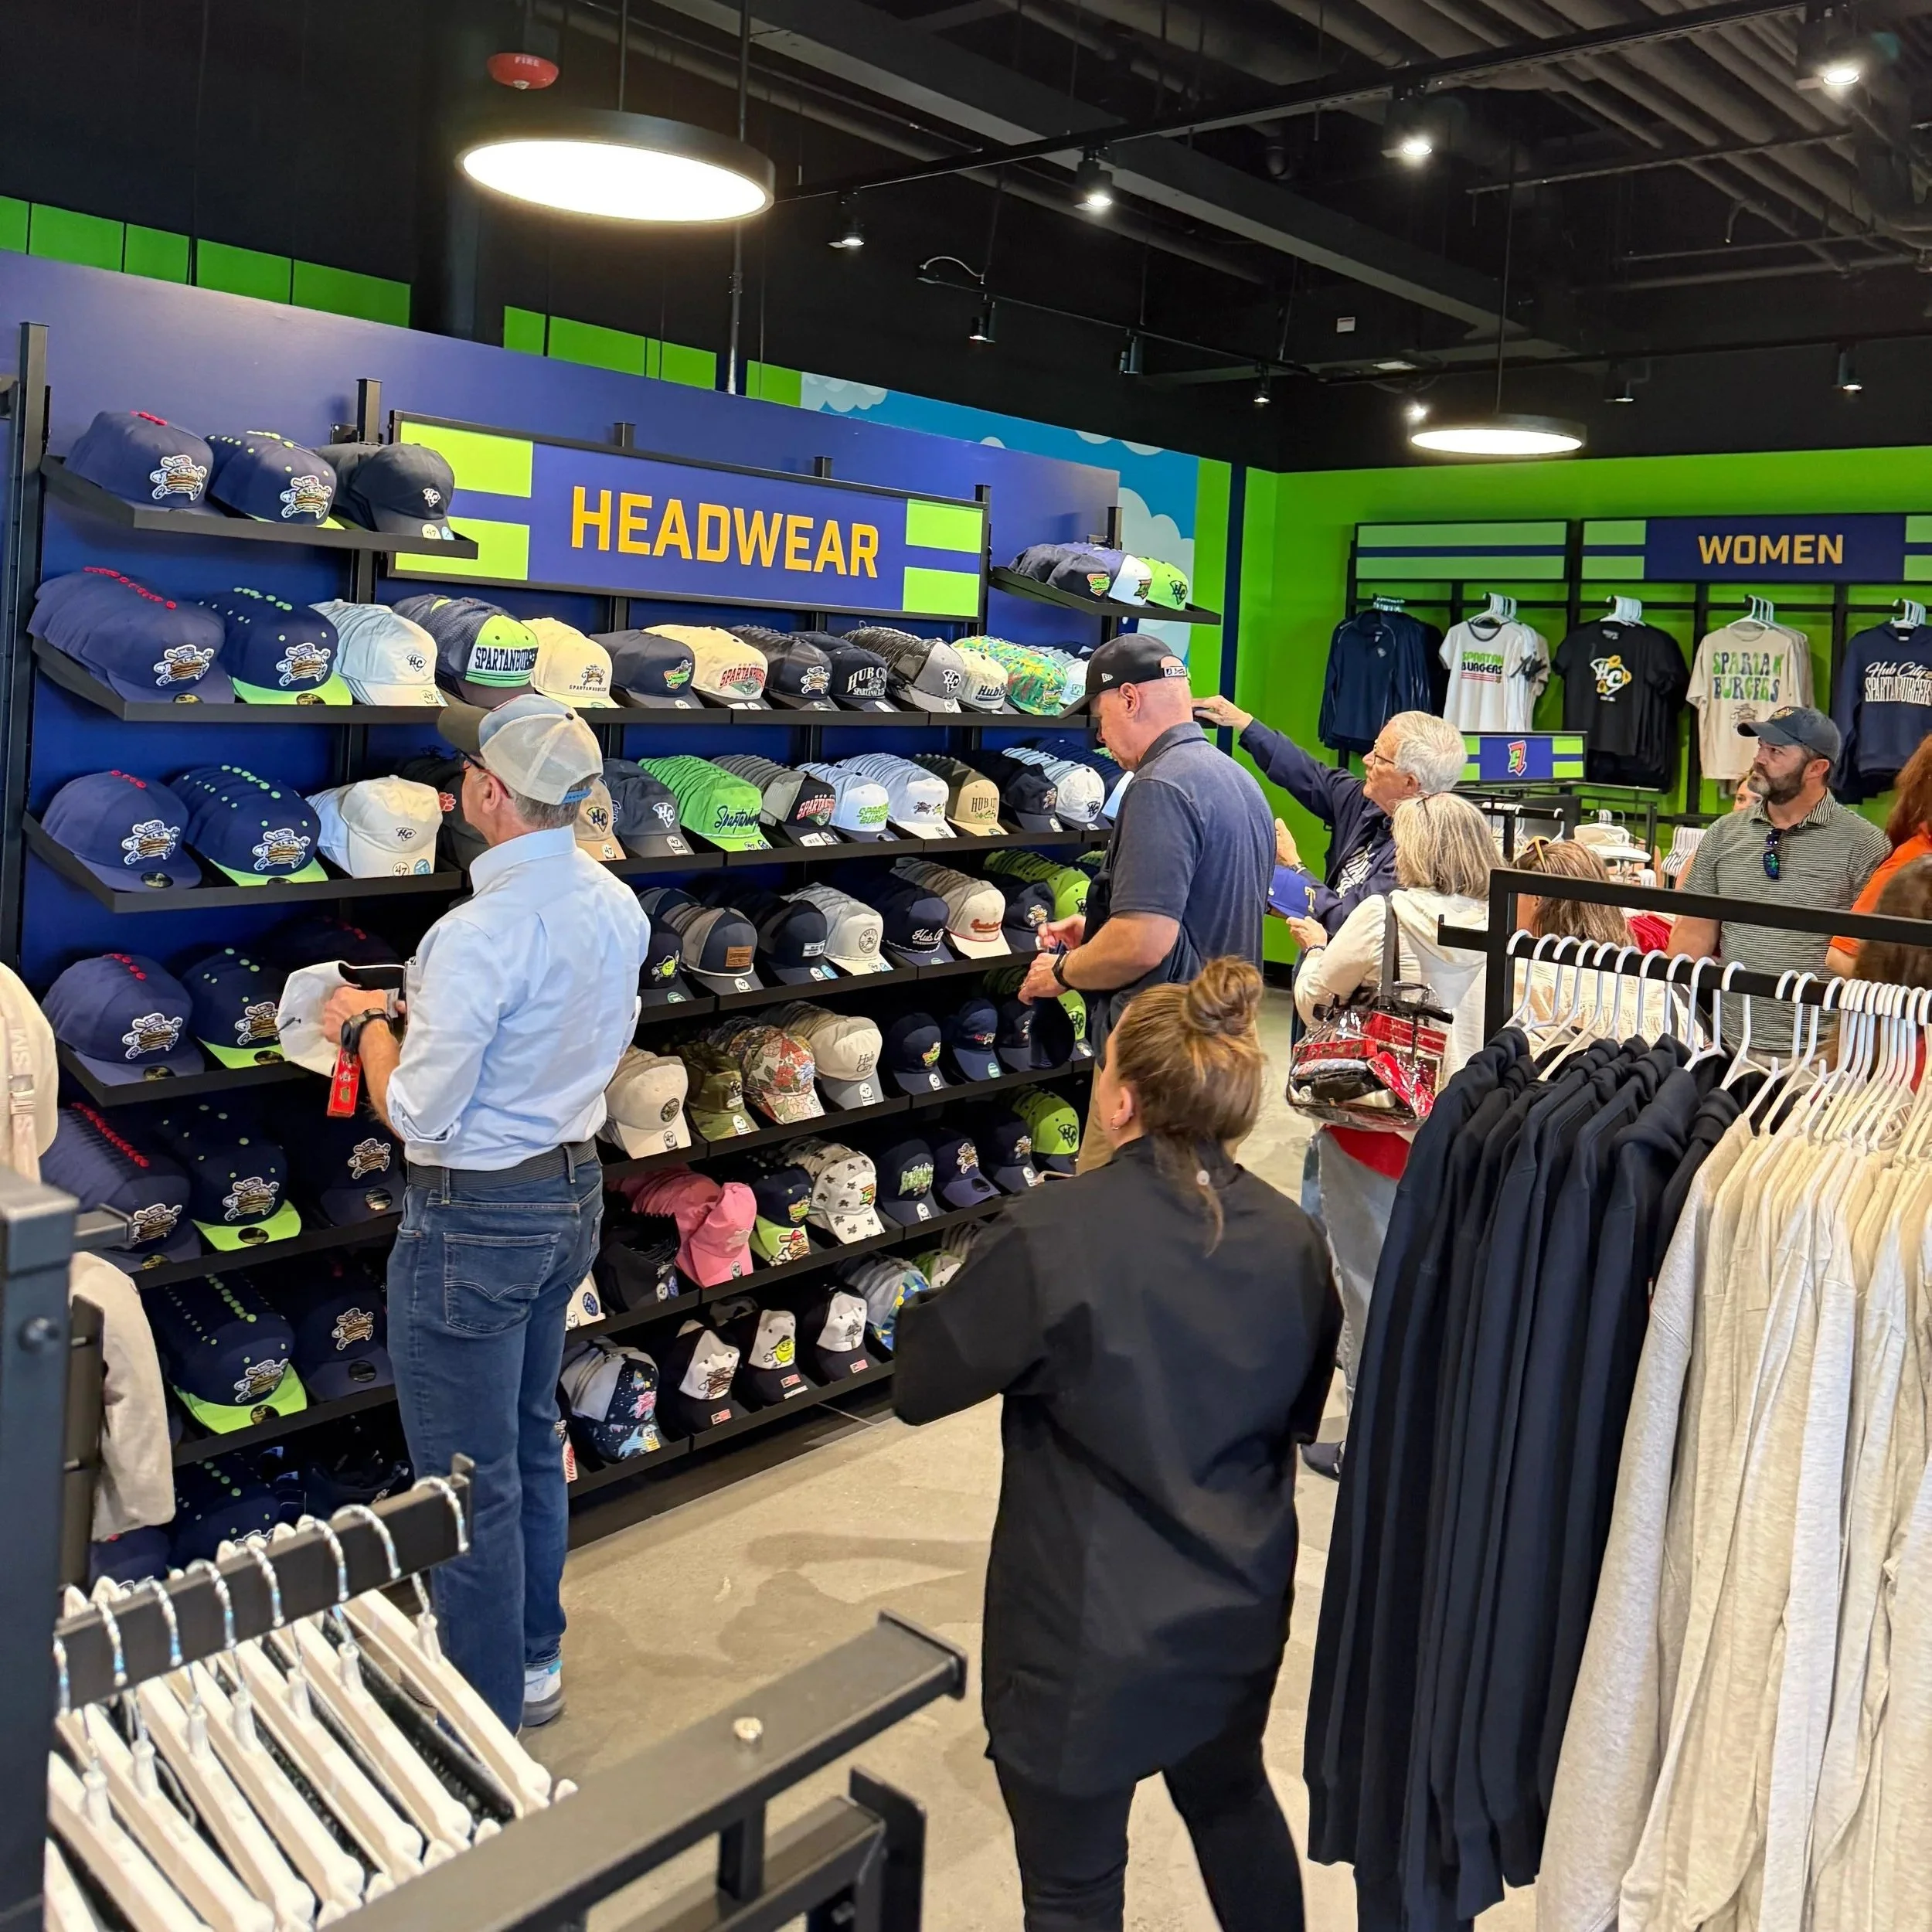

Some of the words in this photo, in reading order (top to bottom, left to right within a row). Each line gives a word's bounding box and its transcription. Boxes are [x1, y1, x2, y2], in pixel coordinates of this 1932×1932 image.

[570, 485, 879, 579] HEADWEAR
[1698, 534, 1844, 565] WOMEN
[1713, 651, 1784, 676] SPARTAN
[1865, 661, 1897, 677] Hub
[1896, 661, 1929, 682] City
[846, 666, 875, 693] HUB
[1713, 676, 1781, 702] BURGERS
